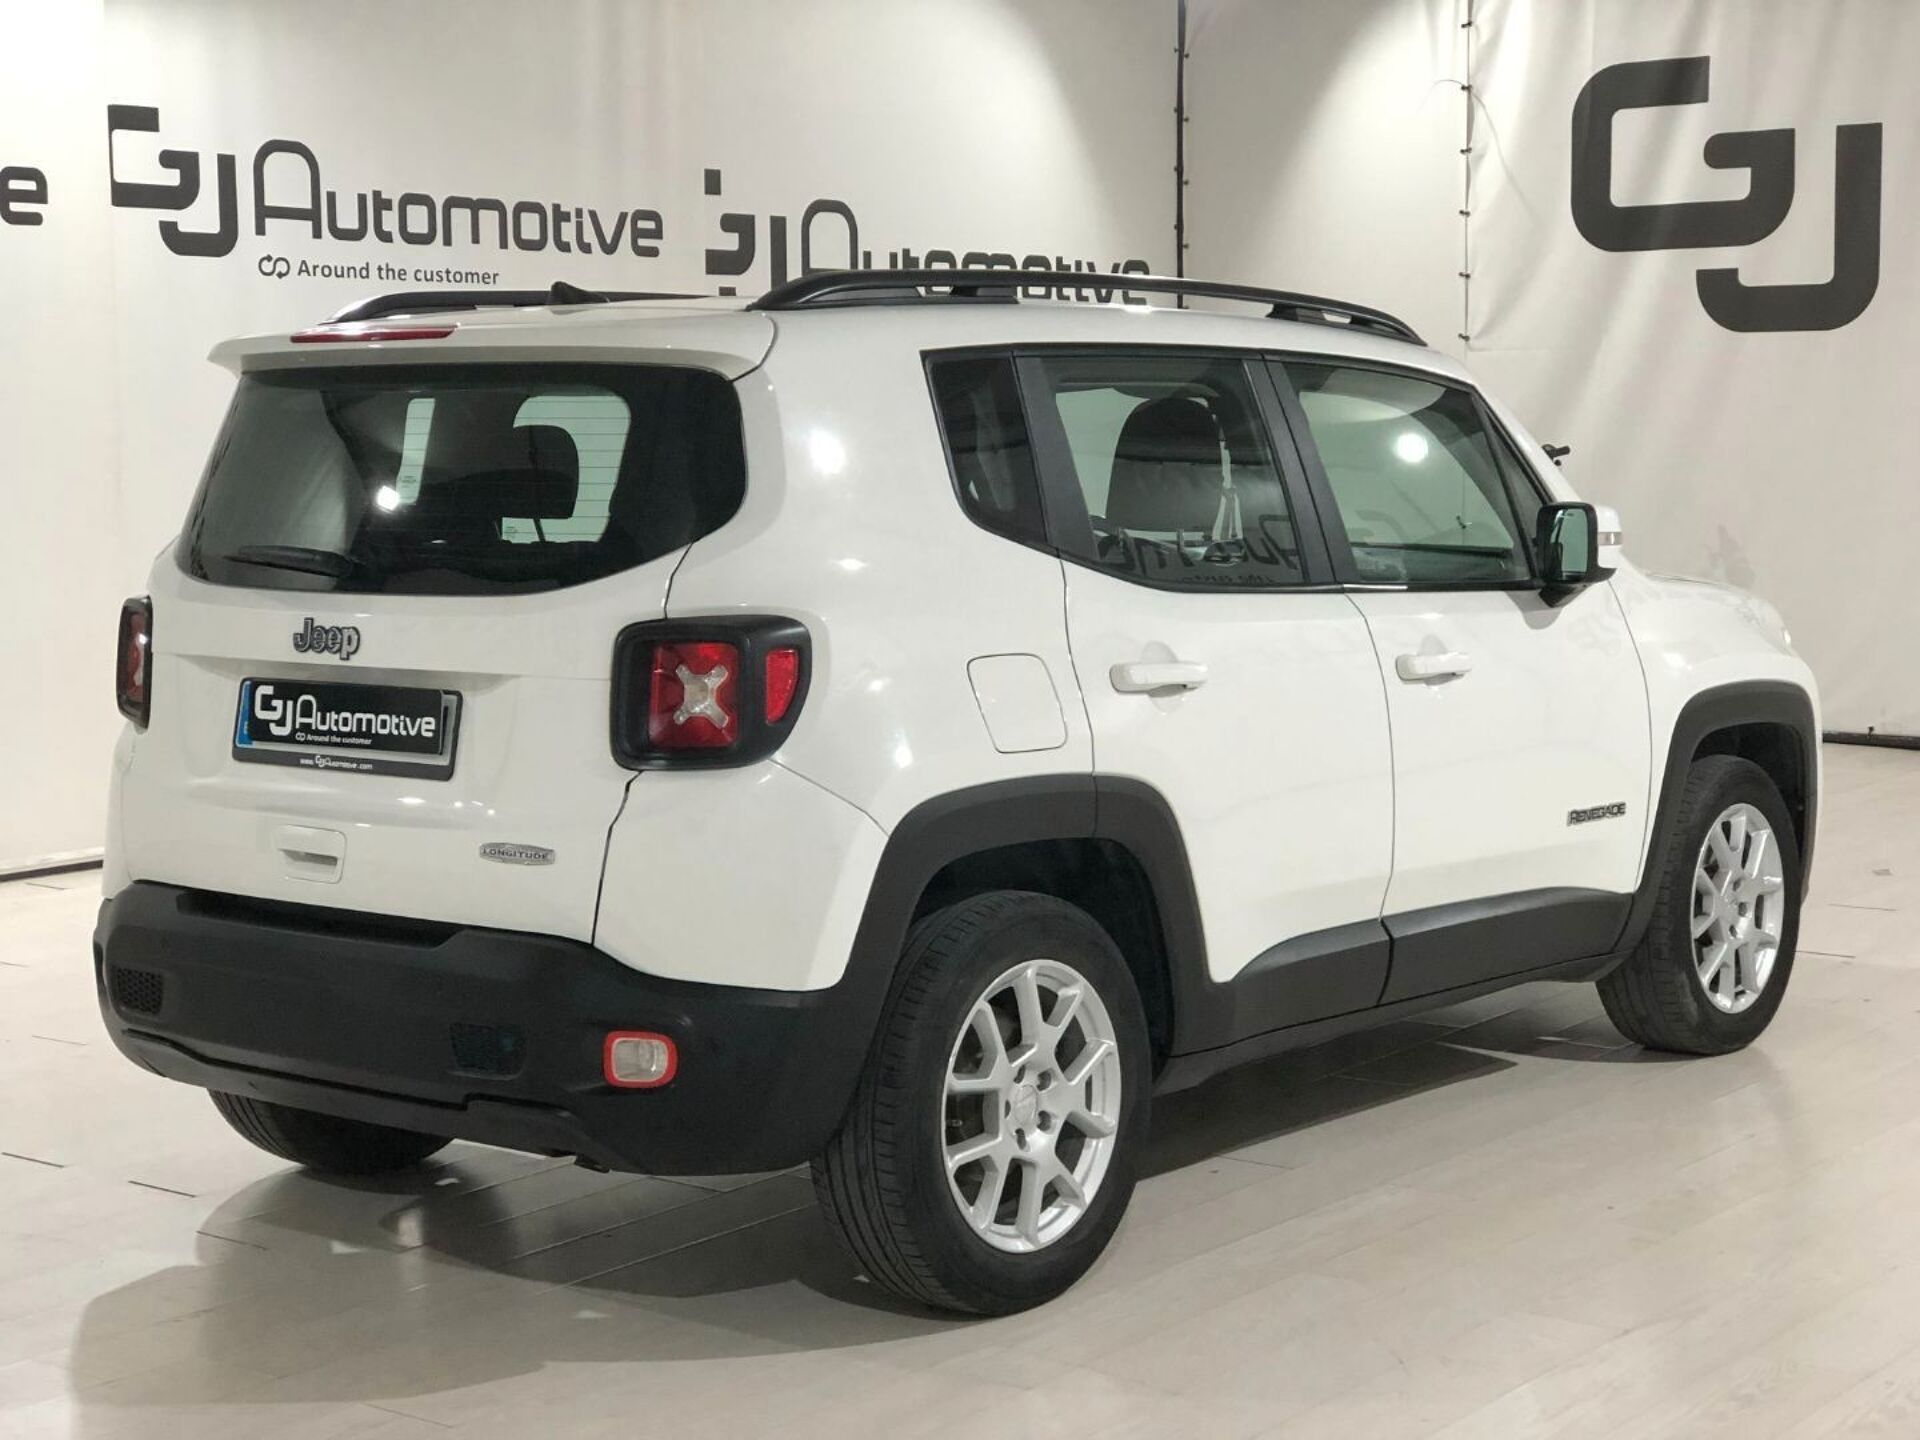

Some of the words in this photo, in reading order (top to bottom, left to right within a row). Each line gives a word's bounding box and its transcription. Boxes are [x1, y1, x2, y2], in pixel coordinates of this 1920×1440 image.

[253, 139, 664, 258] Automotive
[297, 259, 370, 280] Around
[376, 262, 408, 282] the
[413, 267, 500, 285] customer
[293, 617, 361, 660] Jeep
[295, 694, 436, 737] Automotive
[1567, 802, 1626, 826] RENEGADE
[482, 847, 549, 861] LONGITUDE
